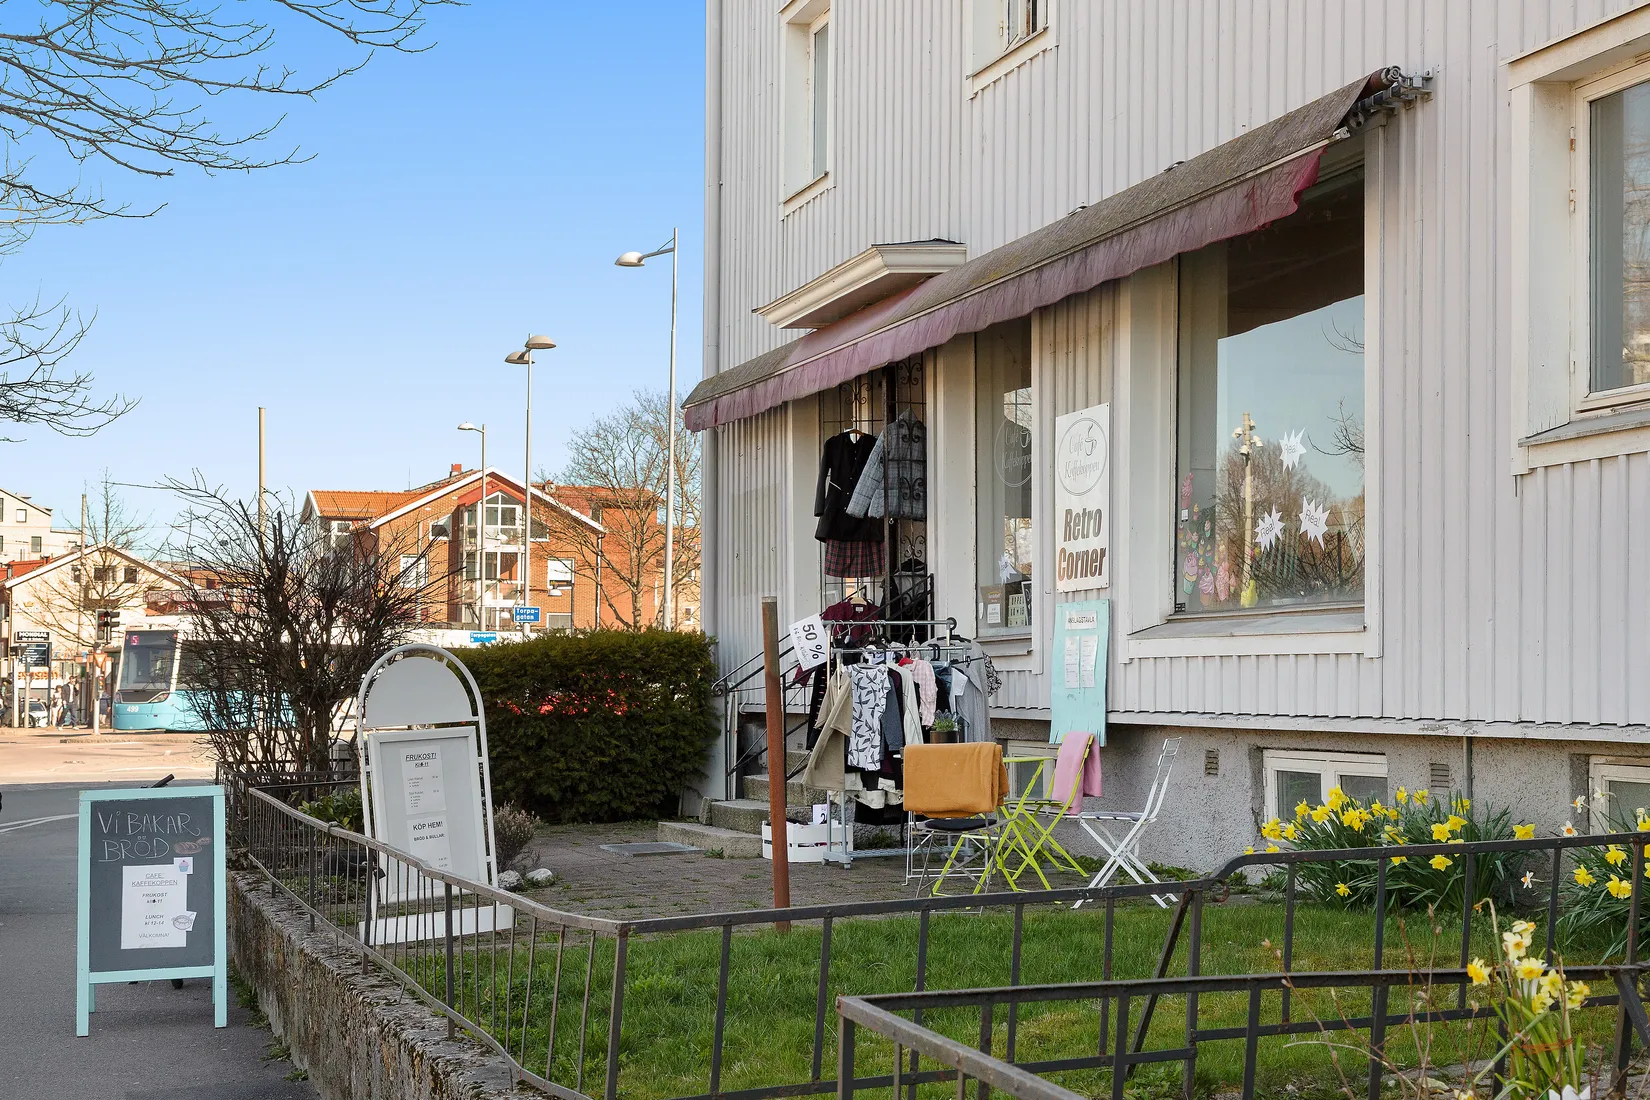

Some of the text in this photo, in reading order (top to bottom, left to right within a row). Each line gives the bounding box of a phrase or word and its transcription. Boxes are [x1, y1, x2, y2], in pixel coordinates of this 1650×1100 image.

[1063, 508, 1102, 542] Retro
[1058, 547, 1106, 581] Corner
[131, 635, 139, 646] 5
[802, 624, 818, 641] 50
[809, 644, 825, 660] %
[405, 752, 437, 761] FRUKOST!
[126, 812, 201, 837] BAKAR
[412, 821, 444, 831] KÖP HEM!
[99, 835, 170, 862] BRÖD
